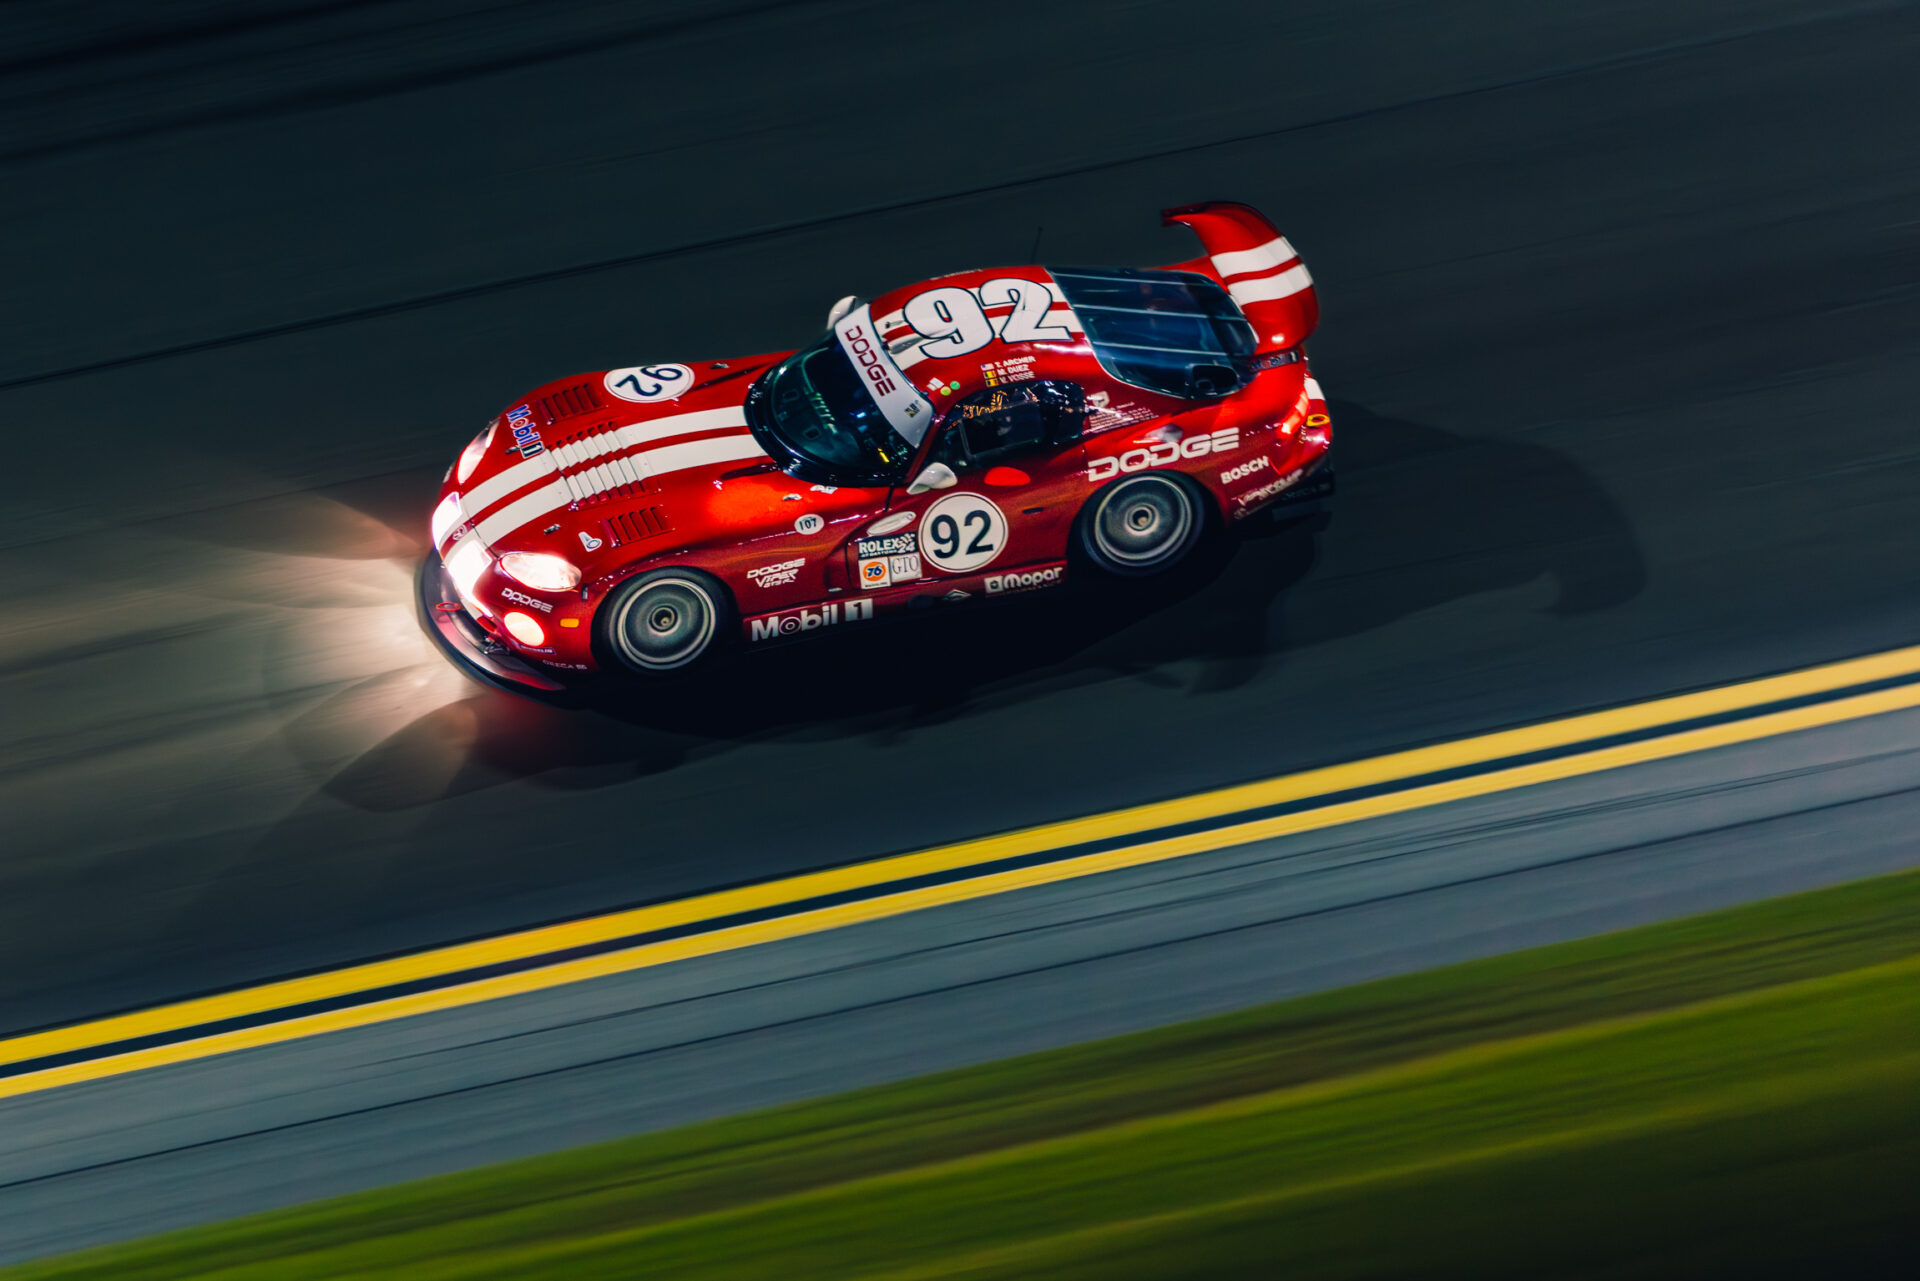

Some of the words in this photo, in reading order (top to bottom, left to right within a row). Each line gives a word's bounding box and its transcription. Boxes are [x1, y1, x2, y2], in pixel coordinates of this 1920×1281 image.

[903, 278, 1074, 359] 92
[844, 325, 897, 397] DODGE
[615, 365, 683, 397] 92
[506, 404, 541, 446] Mobil
[1088, 427, 1239, 482] DODGE
[1220, 455, 1270, 485] BOSCH
[799, 518, 817, 531] 107
[930, 509, 995, 560] 92
[859, 537, 899, 554] ROLEX
[897, 541, 915, 553] 24
[747, 557, 806, 579] DODGE
[755, 569, 799, 588] VIPER
[866, 565, 883, 577] 76
[892, 556, 919, 575] GTO
[501, 587, 554, 614] DODGE
[751, 603, 838, 642] Mobil
